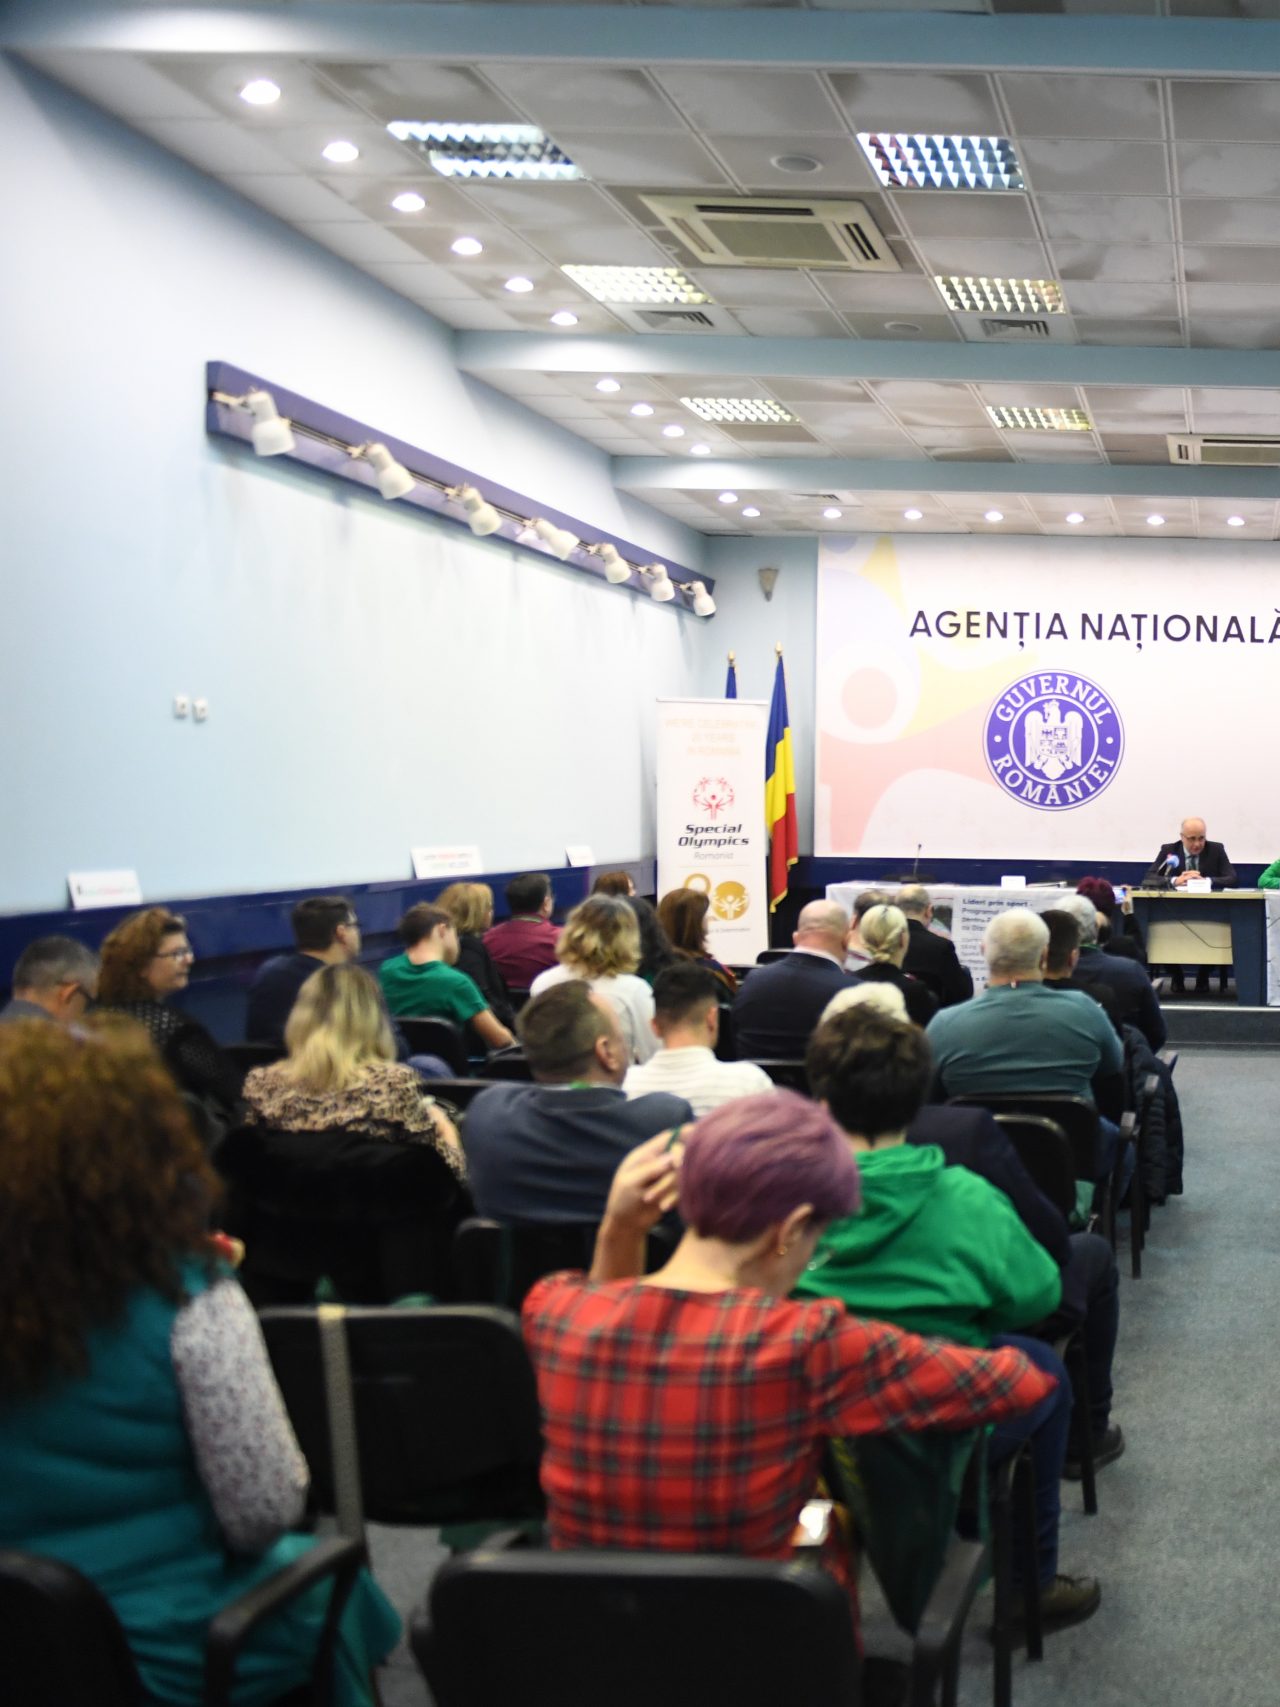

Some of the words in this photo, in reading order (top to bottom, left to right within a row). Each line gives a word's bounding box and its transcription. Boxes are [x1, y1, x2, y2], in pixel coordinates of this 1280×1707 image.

[909, 609, 1069, 652] AGENȚIA
[995, 675, 1113, 725] GUVERNUL
[992, 753, 1115, 805] ROMÂNIEI
[678, 836, 750, 849] Olympics
[685, 824, 743, 836] Special
